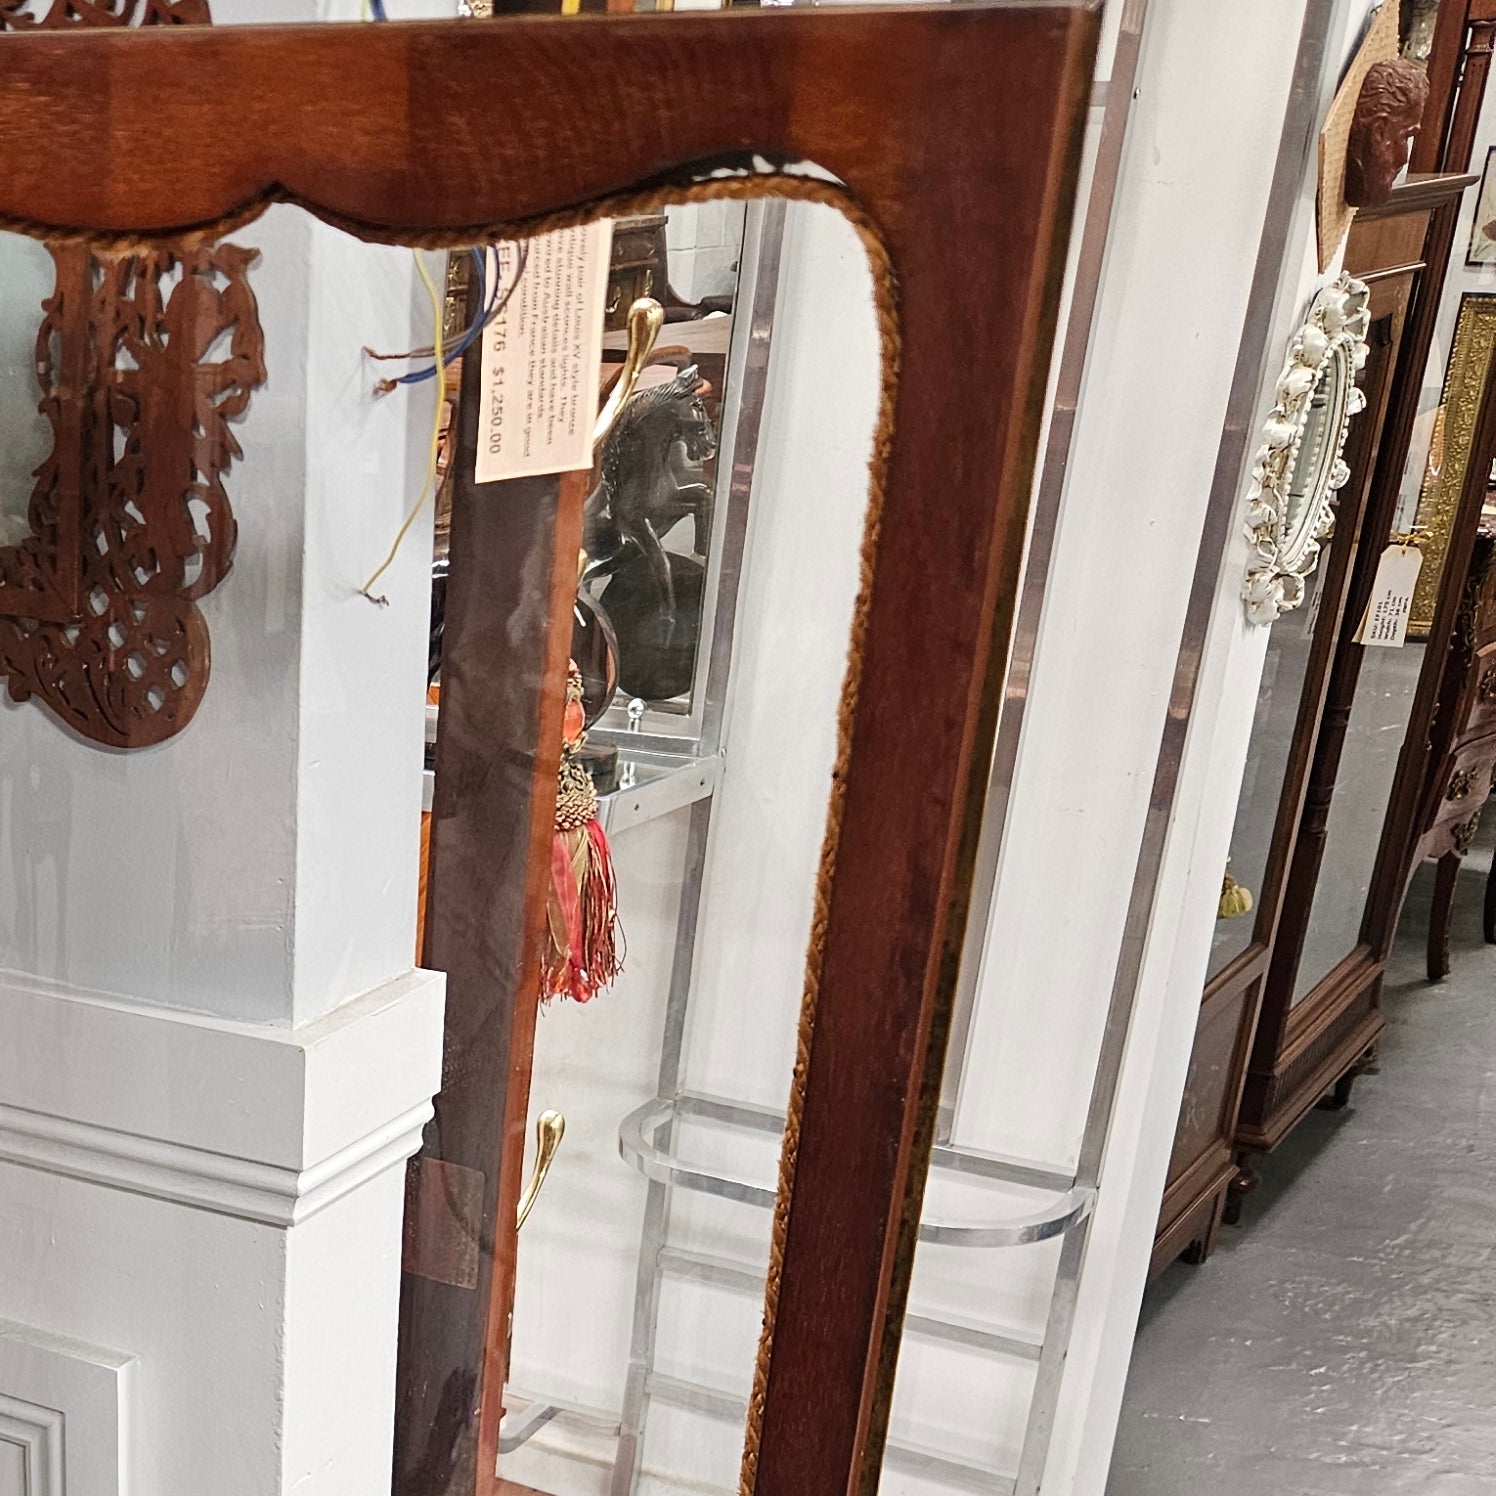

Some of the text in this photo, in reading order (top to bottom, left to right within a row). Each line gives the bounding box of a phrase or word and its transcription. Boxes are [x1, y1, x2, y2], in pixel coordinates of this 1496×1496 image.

[531, 282, 540, 310] from
[544, 276, 551, 288] to
[551, 257, 563, 309] stunning
[565, 273, 573, 297] wall
[528, 314, 538, 356] France
[539, 292, 550, 354] Australian
[551, 313, 560, 353] details
[561, 301, 571, 350] sconces
[568, 227, 587, 435] ovely pair of Louis XV style bronze
[526, 360, 536, 384] they
[489, 367, 505, 454] $1,250.00
[548, 383, 556, 411] have
[558, 396, 566, 422] They
[526, 413, 532, 423] in
[546, 415, 554, 445] been
[521, 426, 531, 457] good
